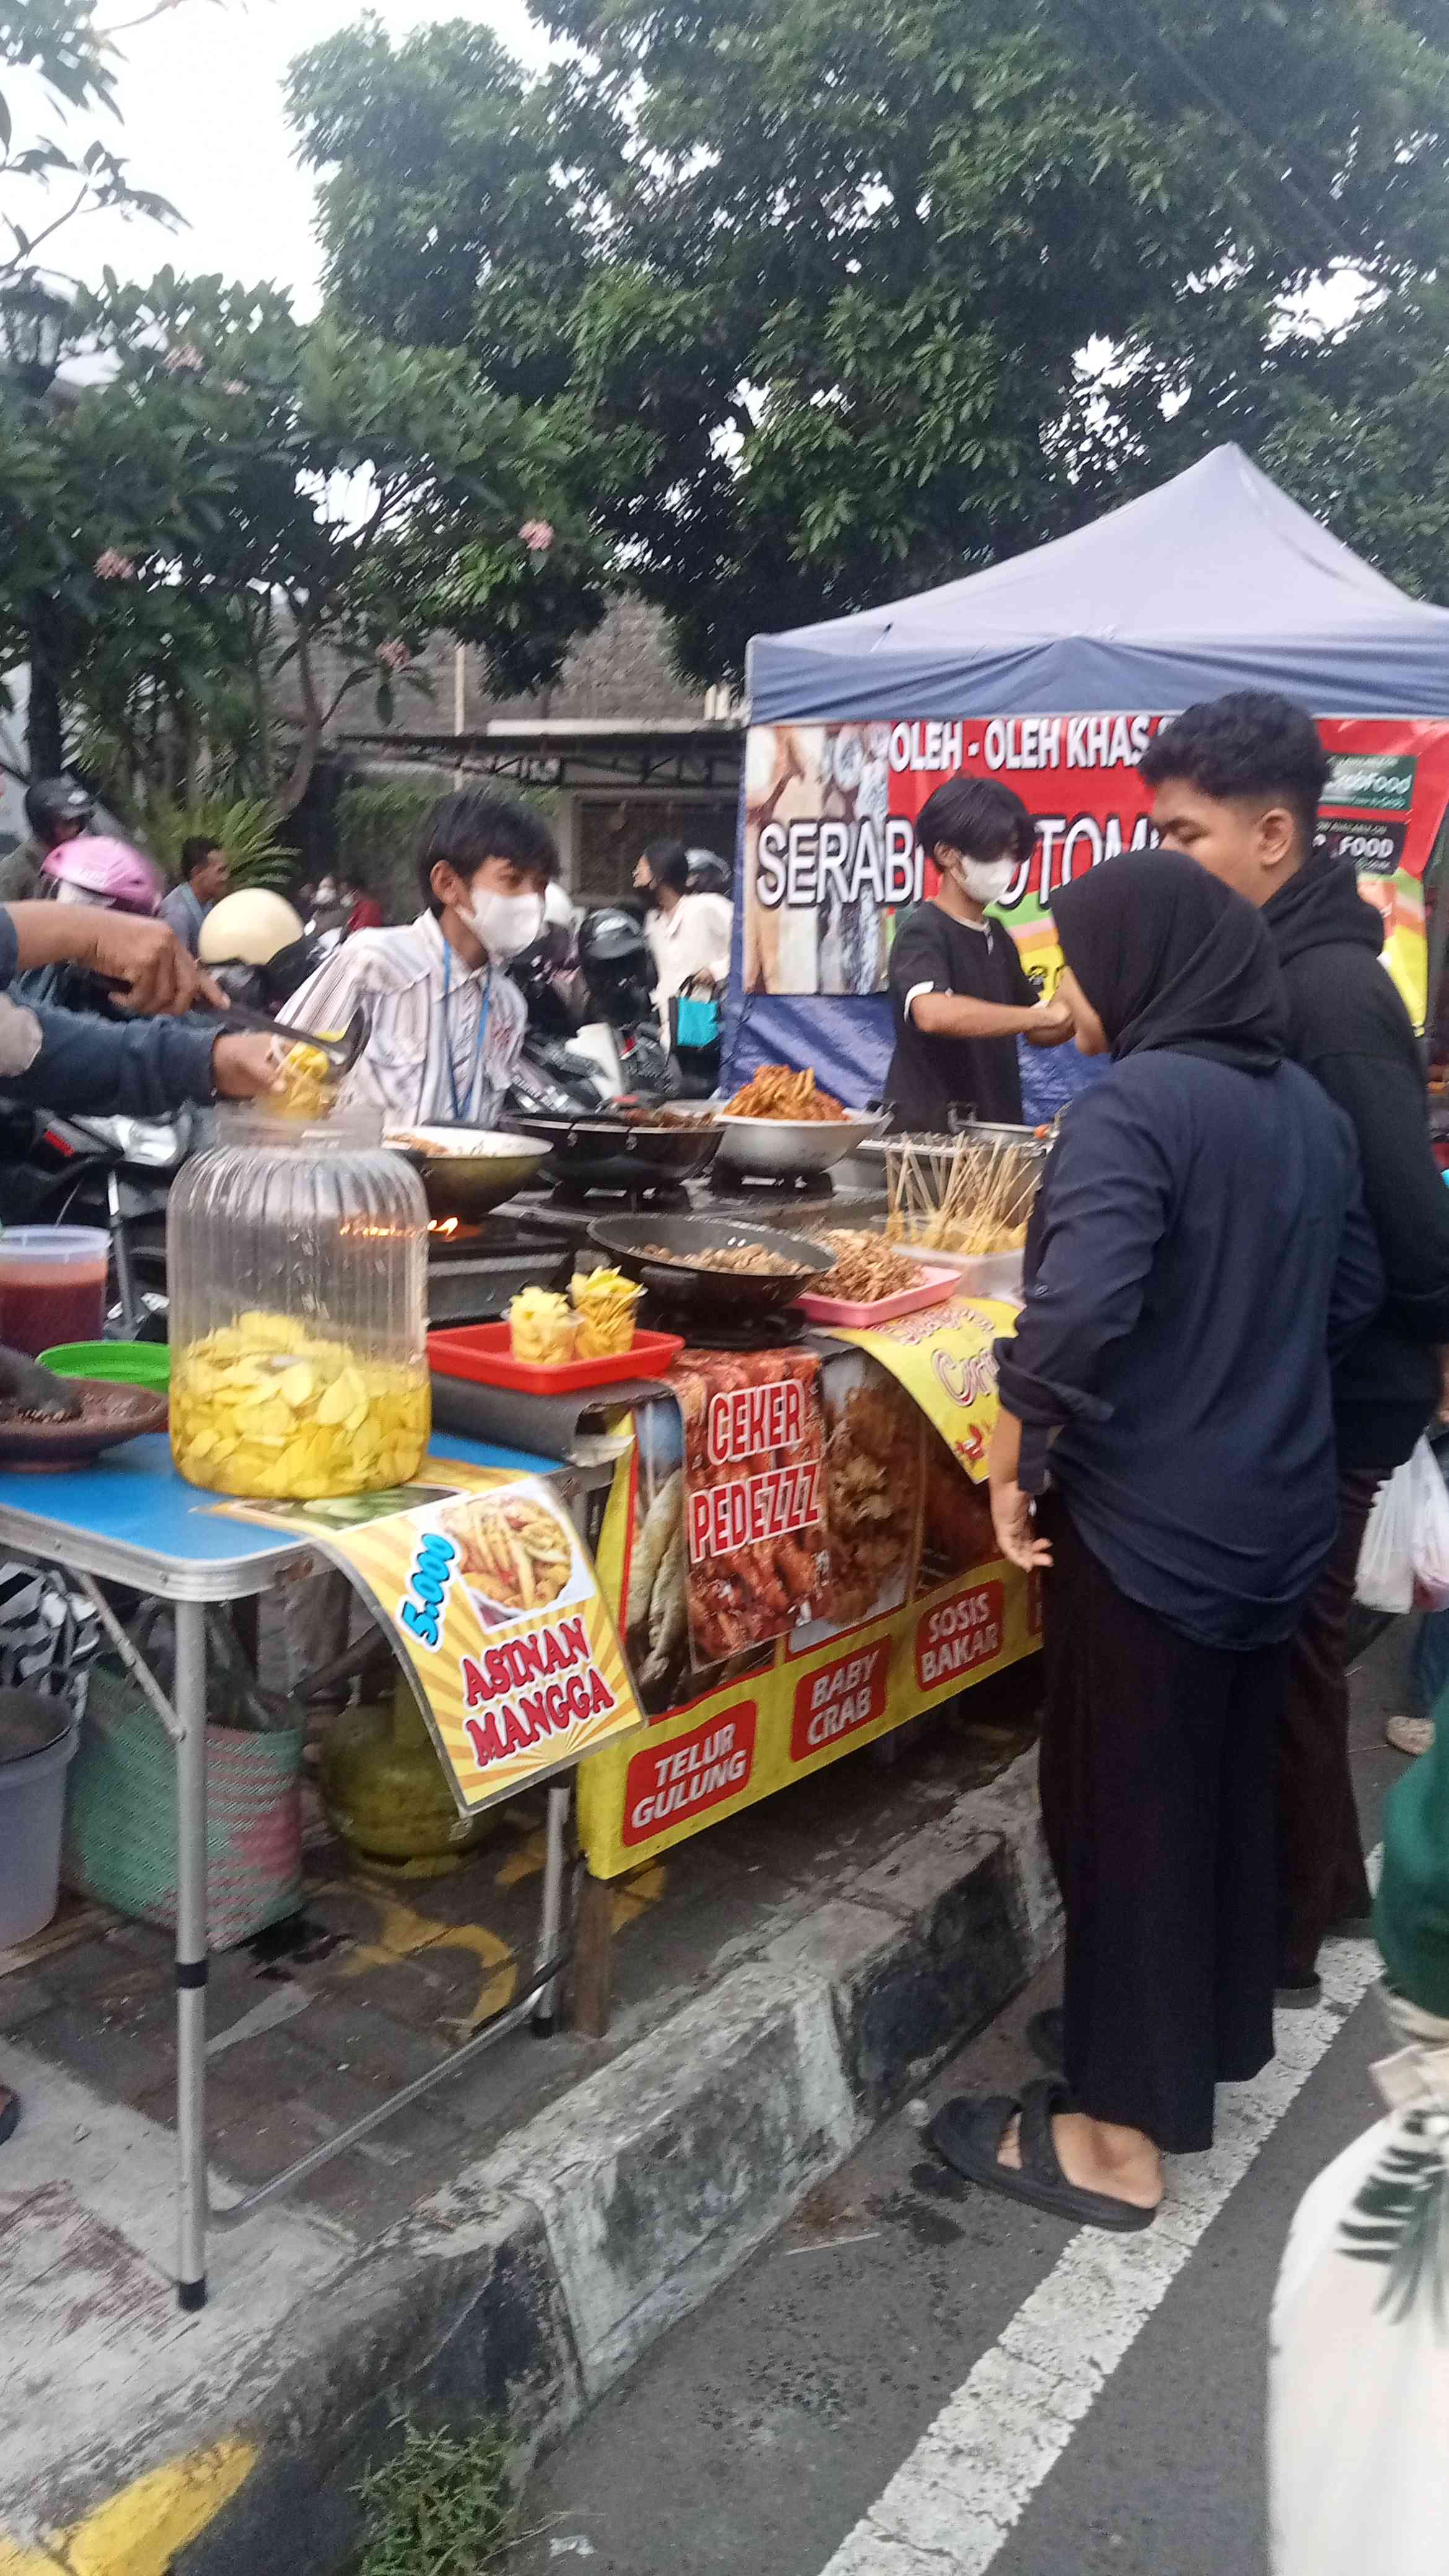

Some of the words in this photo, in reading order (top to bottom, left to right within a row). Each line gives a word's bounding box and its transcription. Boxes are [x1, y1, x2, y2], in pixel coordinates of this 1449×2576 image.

[888, 721, 963, 772] OLEH
[983, 718, 1062, 770] OLEH
[1066, 714, 1151, 768] KHAS
[757, 819, 925, 906] SERABI
[709, 1380, 805, 1464] CEKER
[690, 1461, 820, 1562] PEDEZZZ
[401, 1533, 456, 1647] 5.000
[929, 1591, 991, 1643] SOSIS
[462, 1617, 591, 1707] ASINAN
[811, 1648, 881, 1711] BABY
[920, 1621, 1000, 1684] BAKAR
[465, 1668, 615, 1767] MANGGA
[655, 1722, 736, 1788] TELUR
[807, 1686, 872, 1747] CRAB
[632, 1749, 747, 1829] GULUNG
